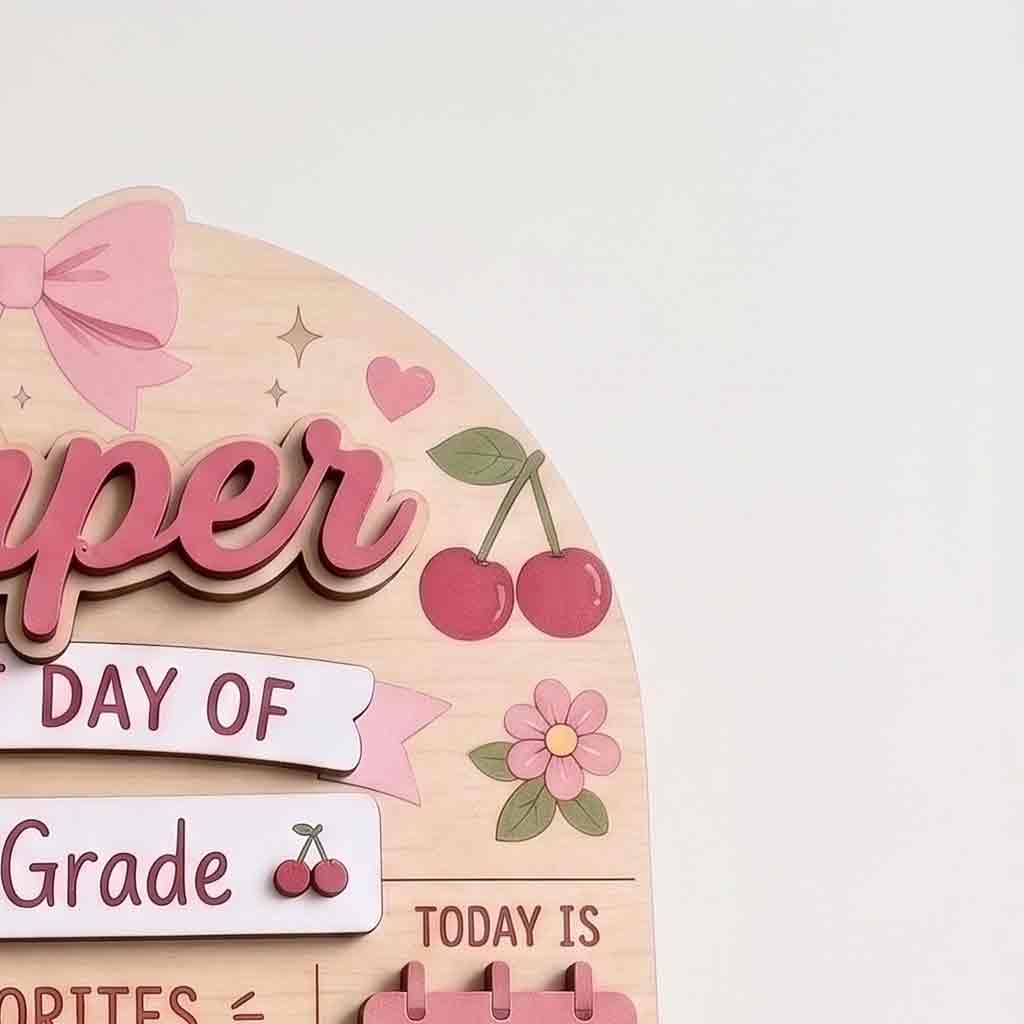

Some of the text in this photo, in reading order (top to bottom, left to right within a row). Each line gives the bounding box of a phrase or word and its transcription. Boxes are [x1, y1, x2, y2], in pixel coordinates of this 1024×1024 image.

[41, 663, 178, 731] DAY
[206, 672, 296, 742] OF
[0, 817, 233, 909] Grade
[414, 904, 601, 948] TODAY IS
